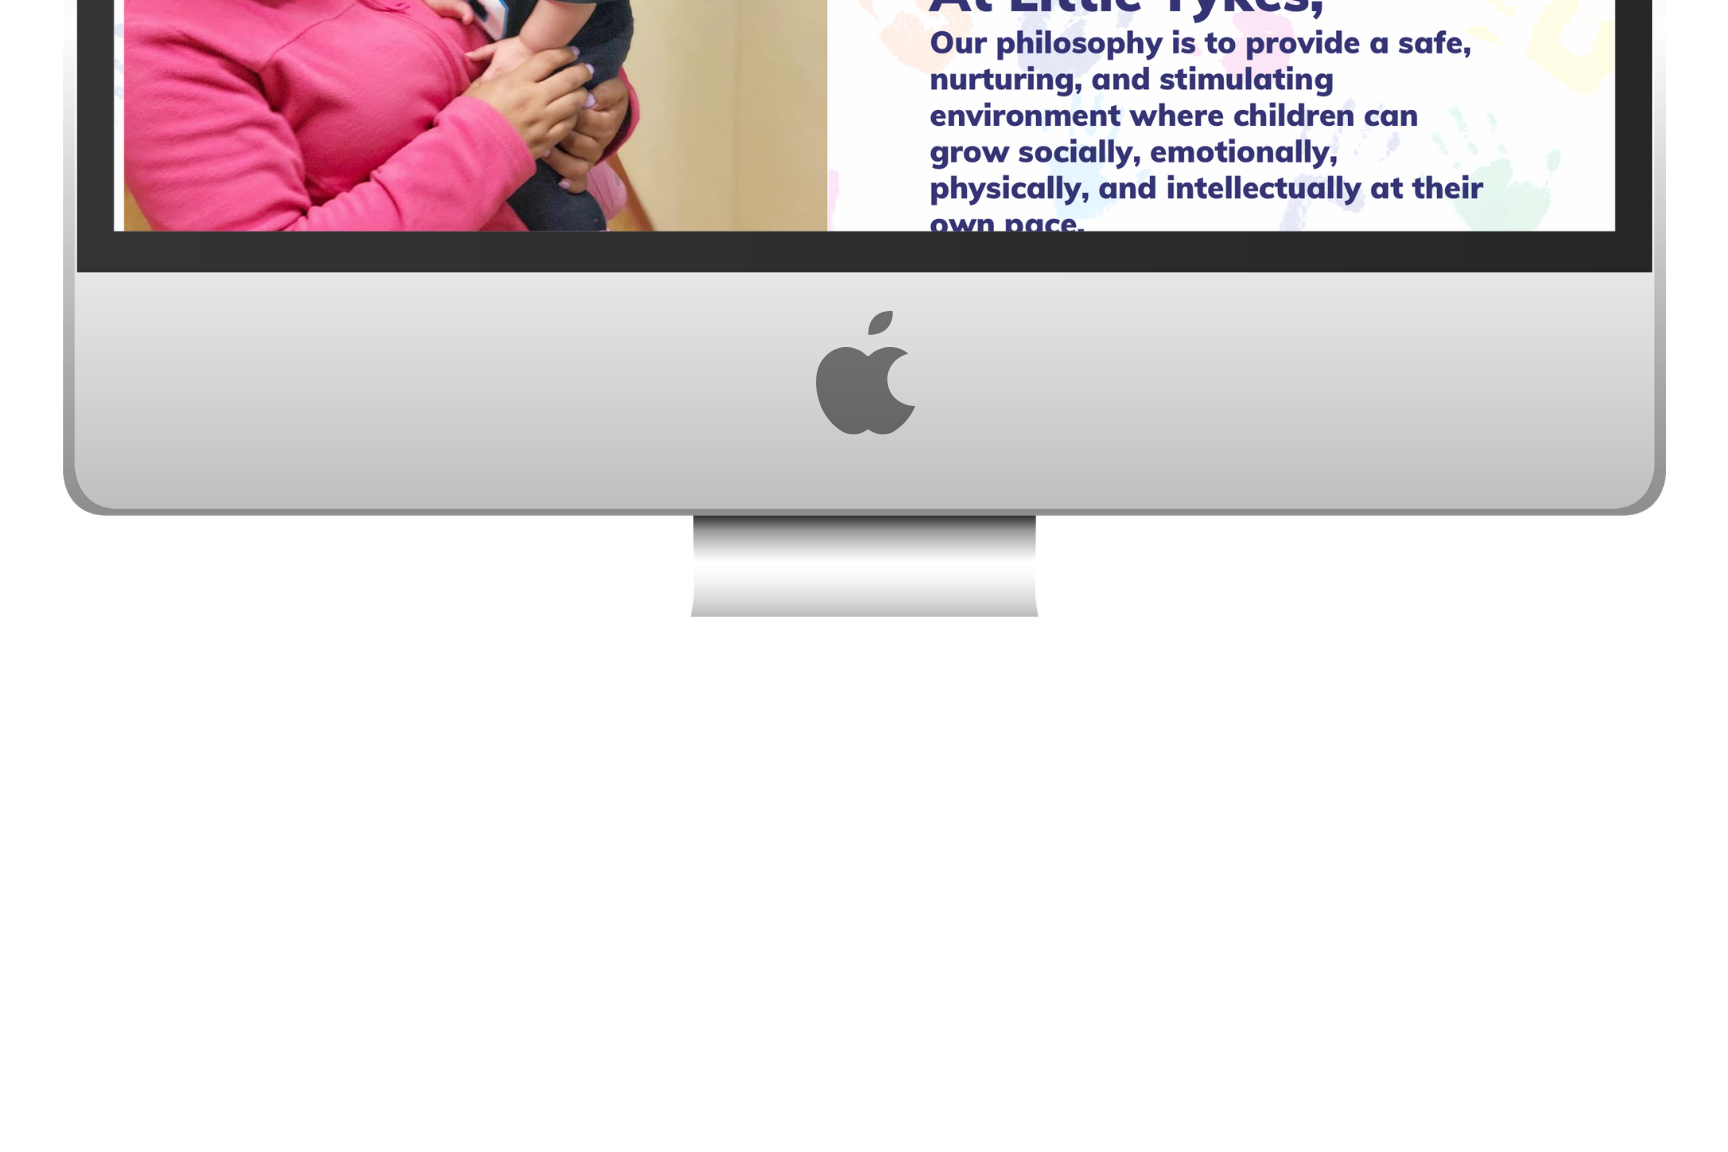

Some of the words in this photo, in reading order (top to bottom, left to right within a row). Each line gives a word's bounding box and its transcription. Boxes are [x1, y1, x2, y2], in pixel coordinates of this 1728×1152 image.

[931, 31, 987, 53] Our
[998, 30, 1163, 60] philosophy
[1173, 30, 1195, 53] is
[1205, 33, 1235, 53] to
[1247, 30, 1359, 60] provide
[1371, 38, 1387, 53] a
[1399, 31, 1470, 57] safe,
[931, 66, 1081, 96] nurturing,
[1093, 67, 1149, 89] and
[1161, 66, 1332, 96] stimulating
[931, 103, 1120, 126] environment
[1130, 103, 1223, 126] where
[1235, 103, 1353, 126] children
[1365, 110, 1417, 126] can
[931, 146, 1009, 169] grow
[1019, 139, 1140, 169] socially,
[1151, 139, 1336, 169] emotionally,
[931, 175, 1088, 205] physically,
[1100, 176, 1155, 198] and
[1168, 175, 1361, 205] intellectually
[1371, 178, 1403, 198] at
[1412, 175, 1483, 198] their
[930, 218, 995, 231] own
